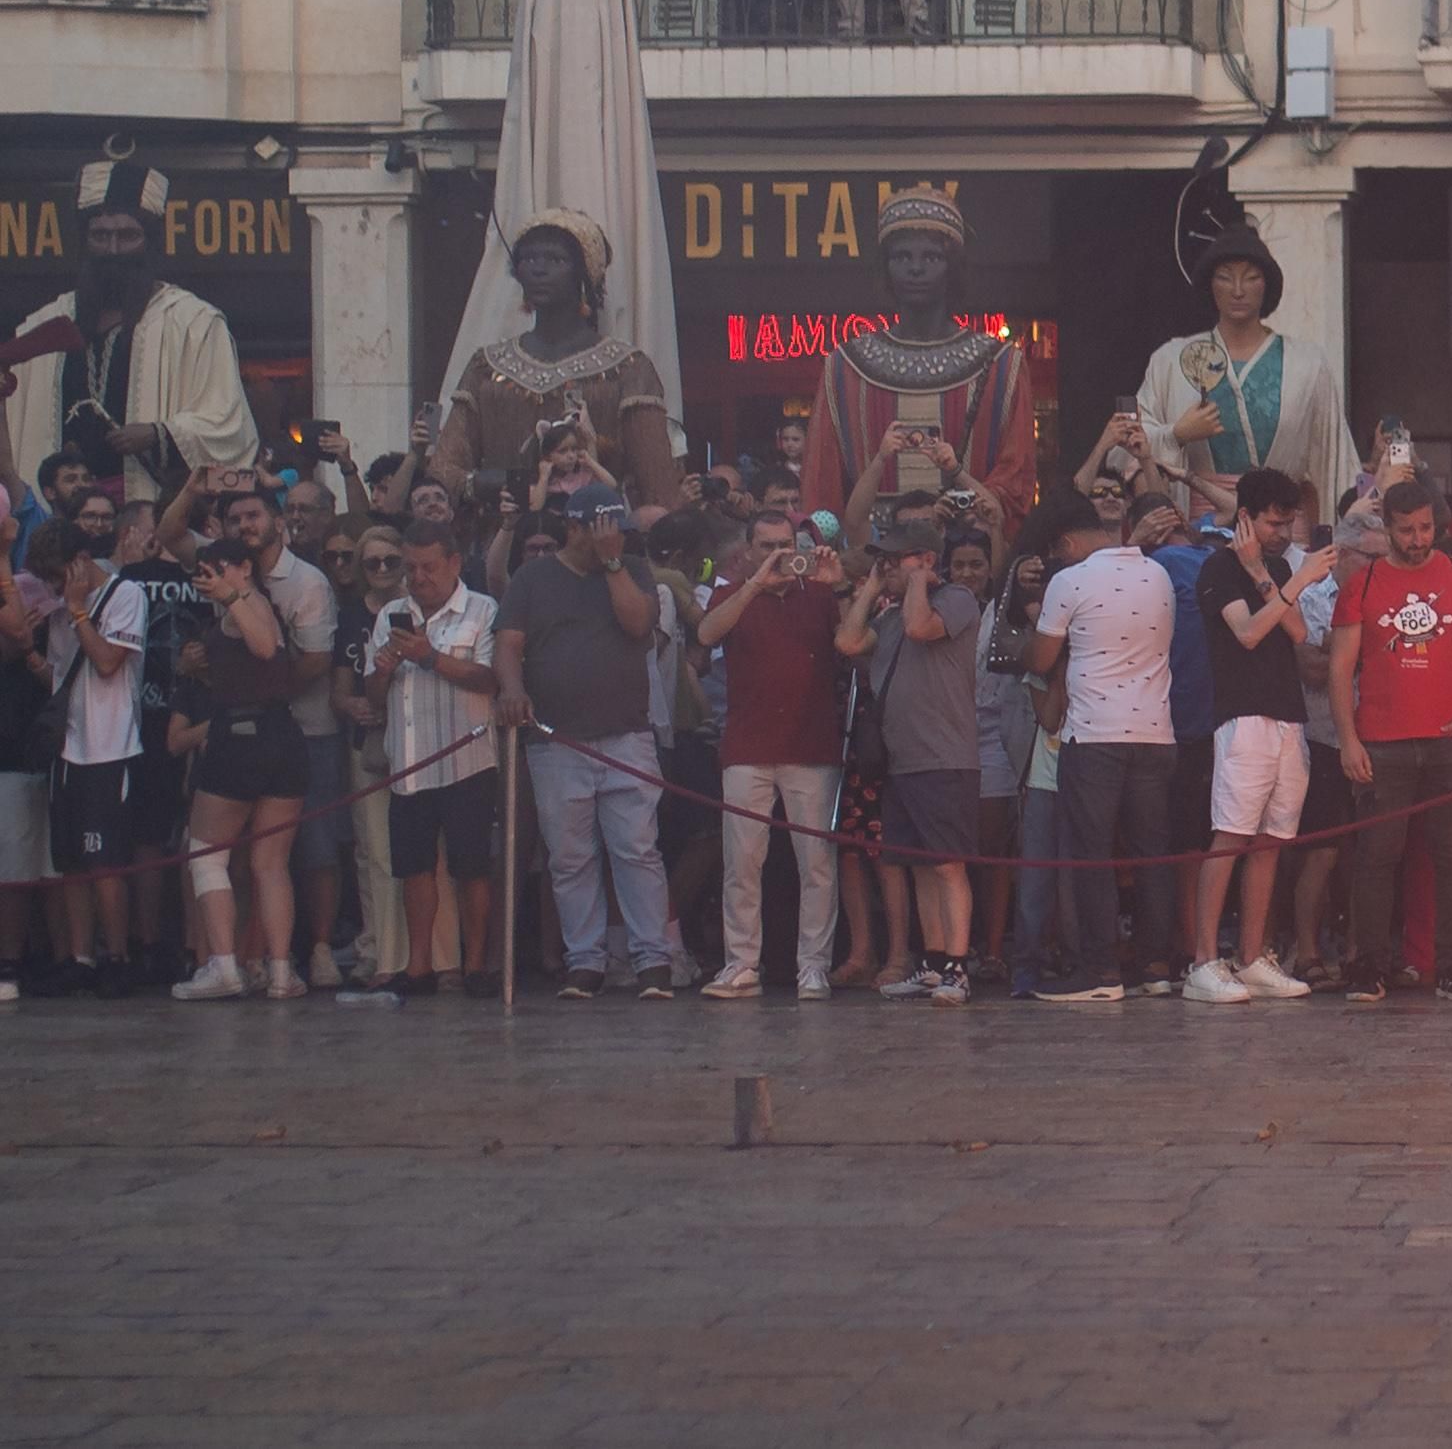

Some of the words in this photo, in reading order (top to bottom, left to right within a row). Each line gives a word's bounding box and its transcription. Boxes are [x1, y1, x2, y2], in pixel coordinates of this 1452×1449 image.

[165, 198, 292, 256] FORN
[685, 181, 960, 259] DITA
[1401, 616, 1433, 631] FOC!
